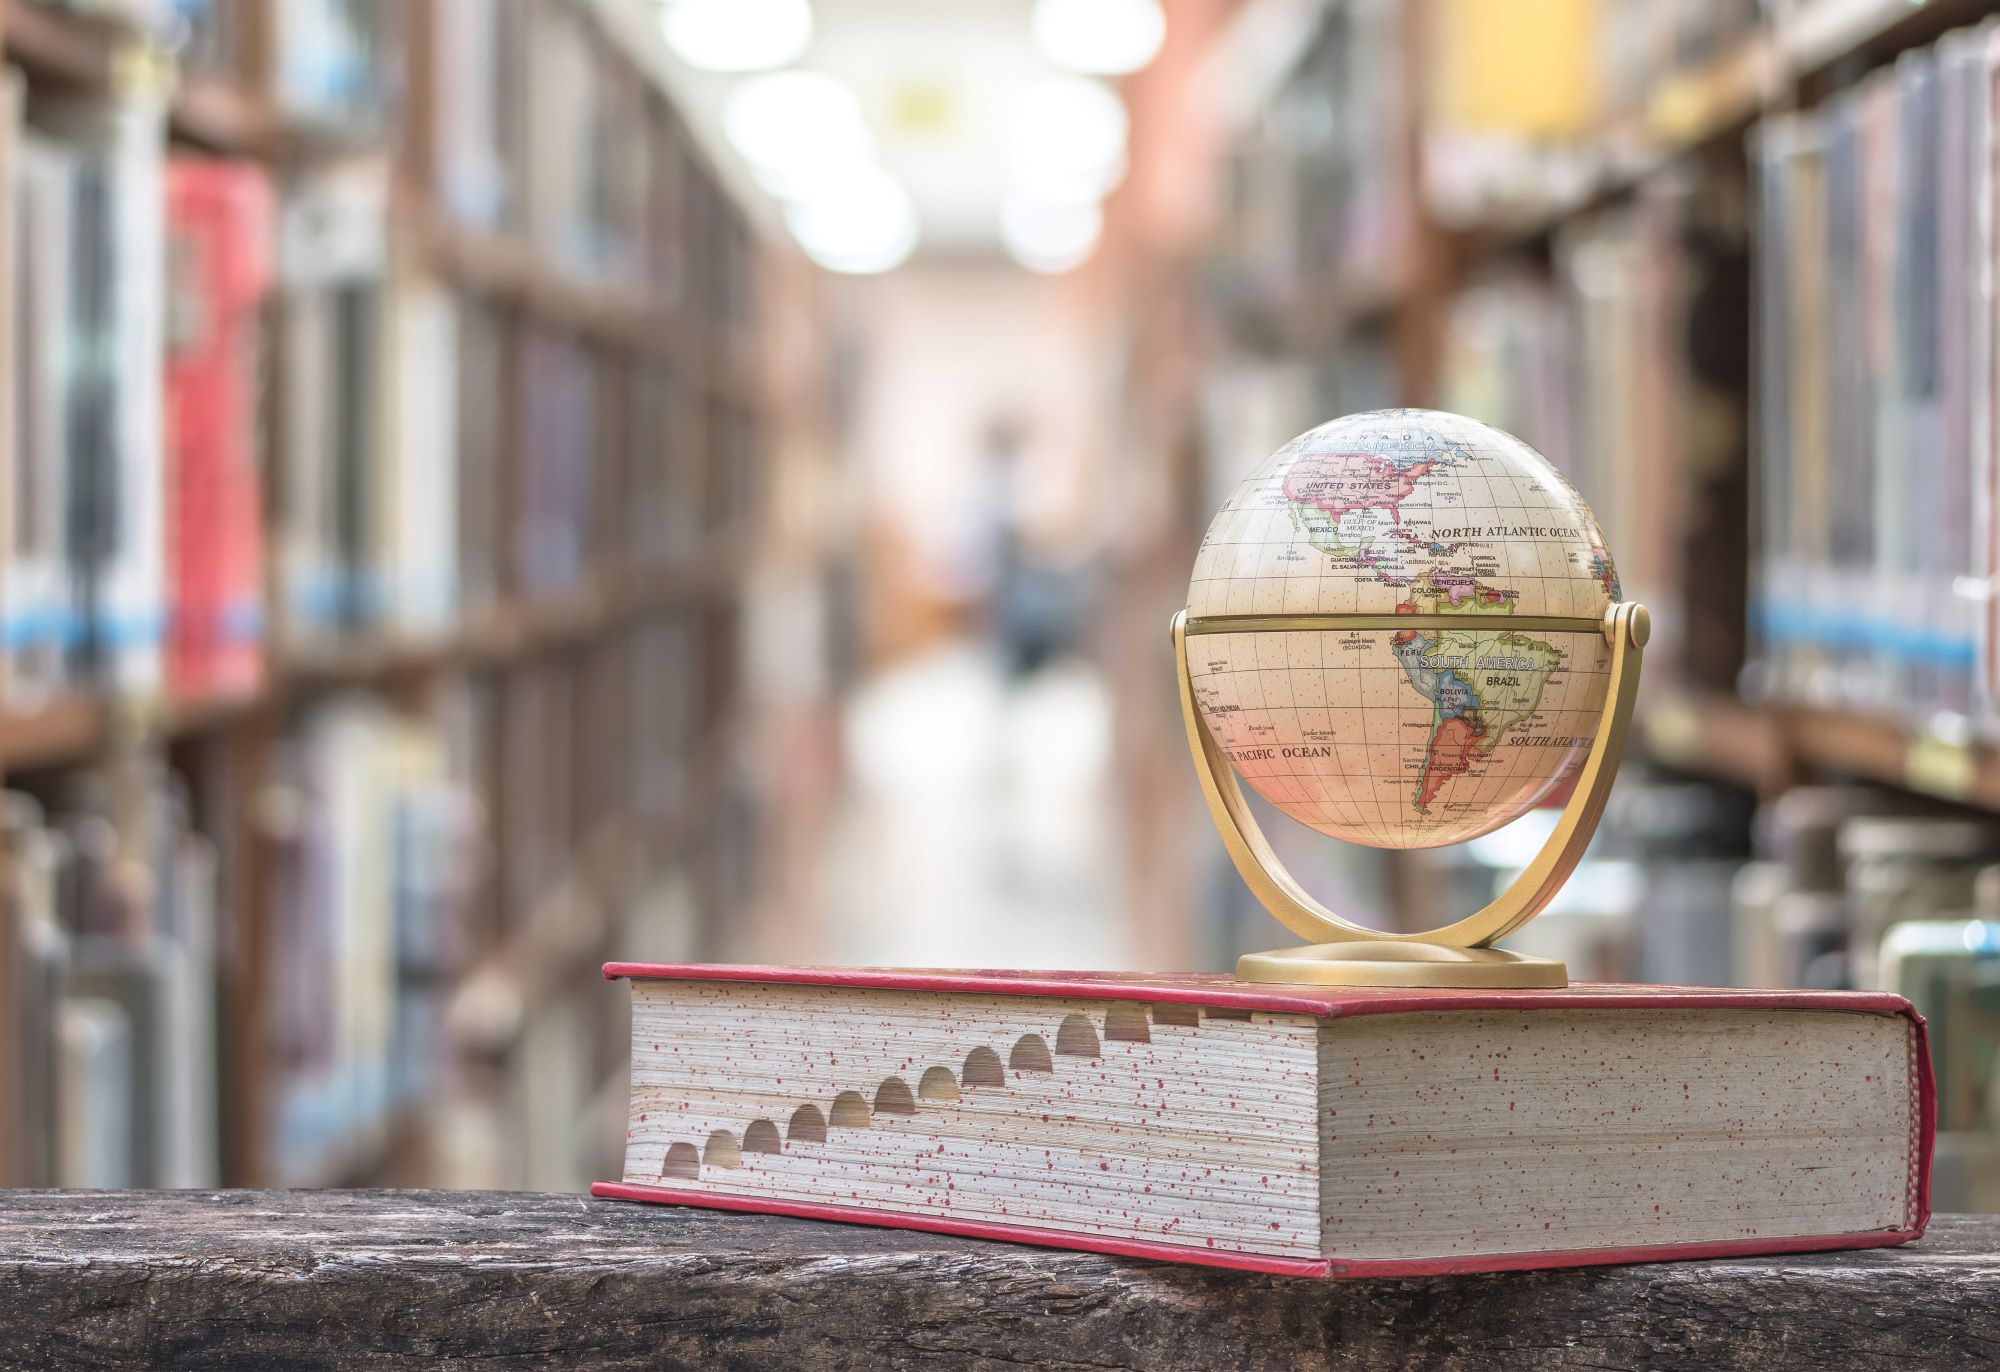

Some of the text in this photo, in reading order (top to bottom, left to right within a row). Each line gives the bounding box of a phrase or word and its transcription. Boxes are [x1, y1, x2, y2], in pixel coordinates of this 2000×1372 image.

[1349, 482, 1391, 490] STATES
[1430, 525, 1580, 539] NORTH ATLANTIC OCEAN
[1432, 579, 1475, 587] VENEZUELA
[1412, 586, 1449, 595] COLOMBIA
[1400, 649, 1422, 657] PERU
[1420, 656, 1536, 671] SOUTH AMERICA
[1486, 676, 1521, 686] BRAZIL
[1440, 688, 1469, 696] BOLIVIA
[1508, 737, 1551, 746] SOUTH
[1237, 746, 1332, 762] PACIFIC OCEAN
